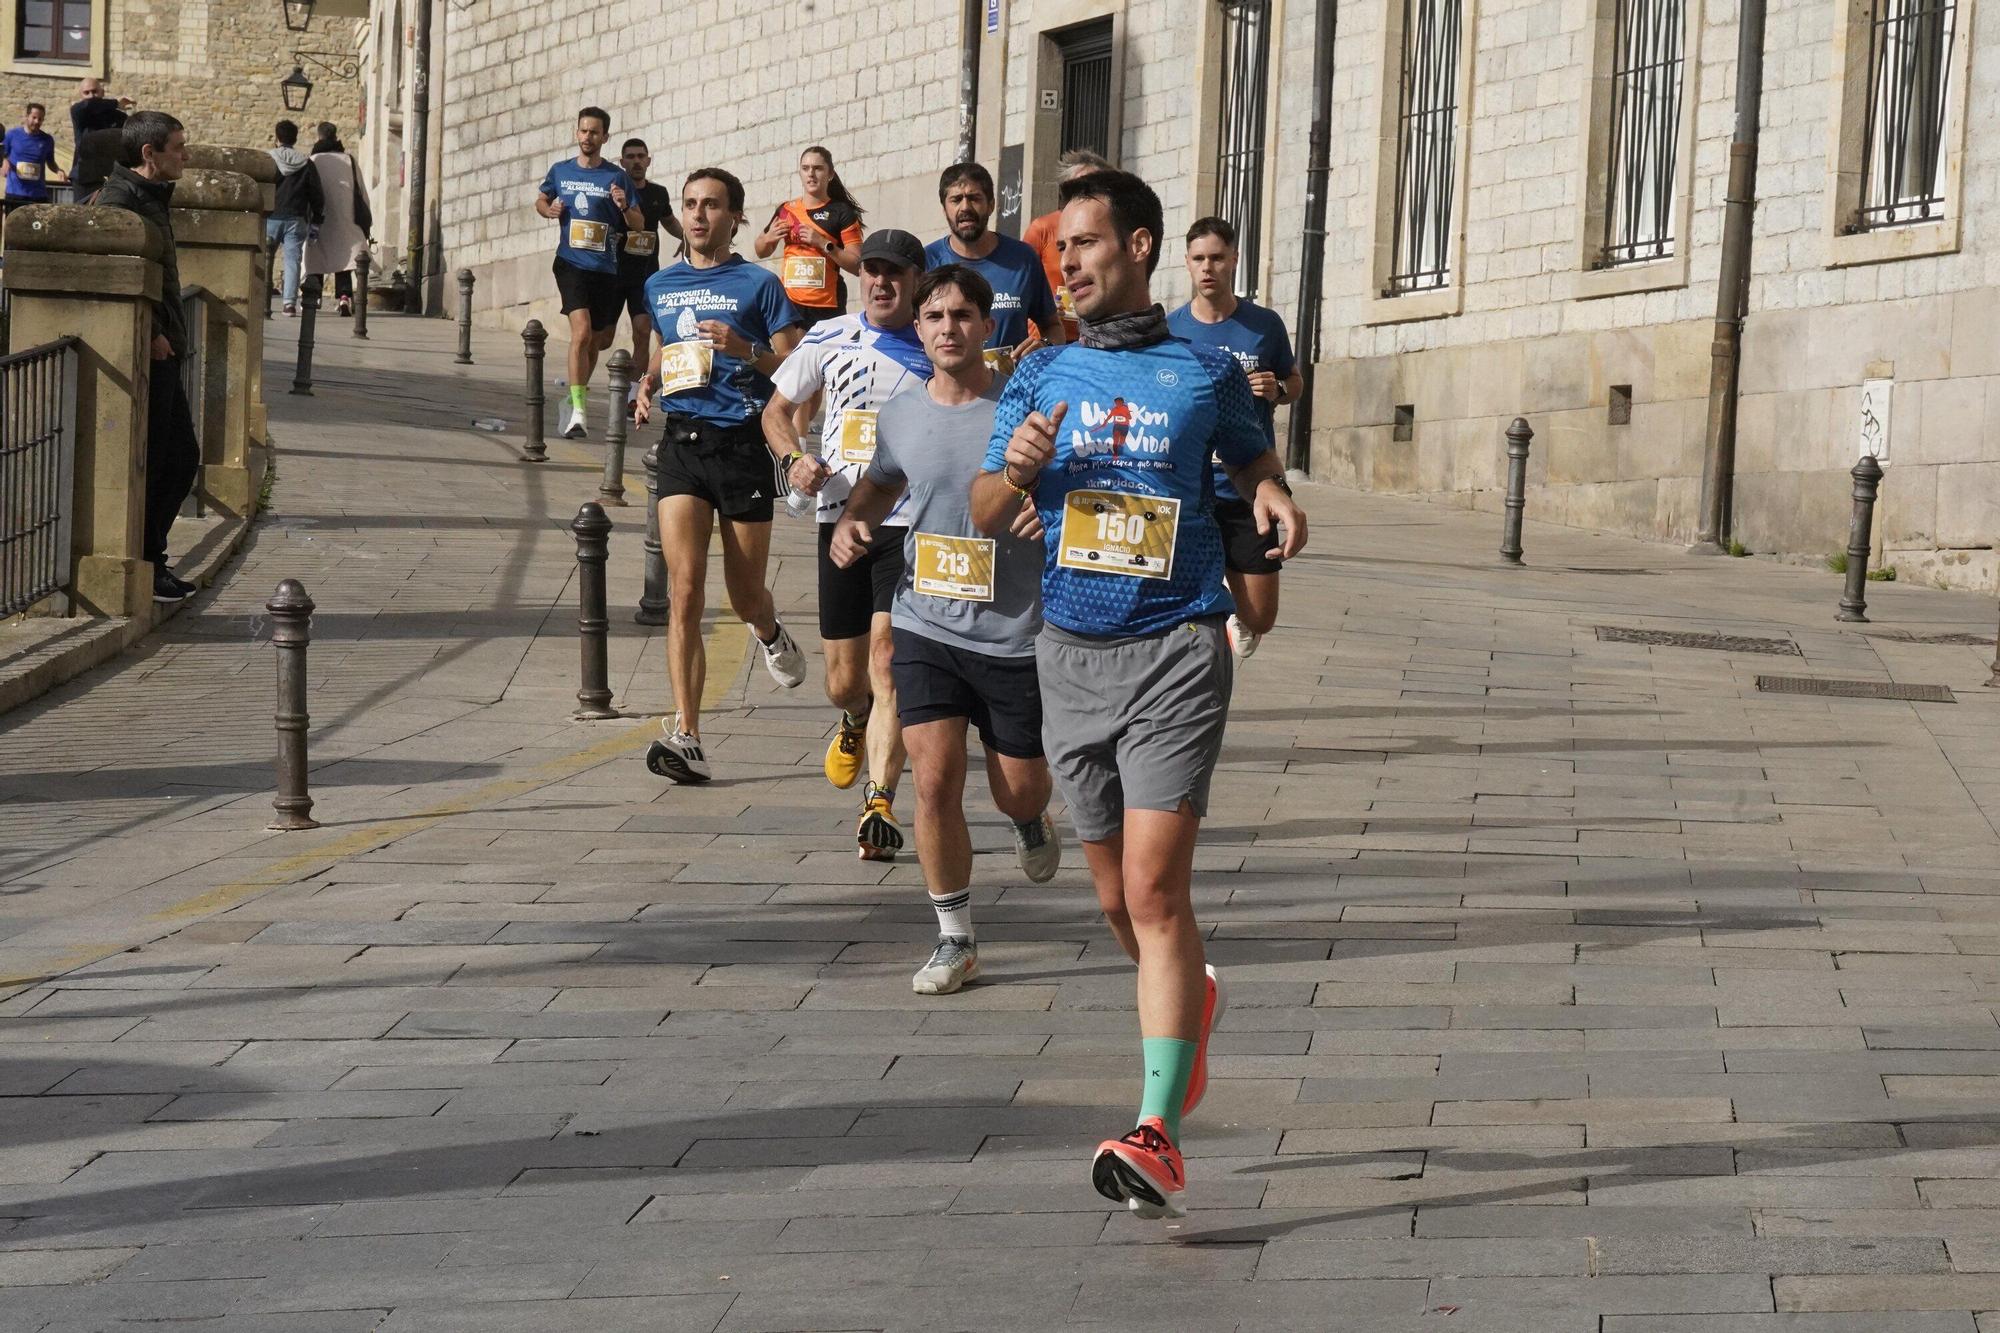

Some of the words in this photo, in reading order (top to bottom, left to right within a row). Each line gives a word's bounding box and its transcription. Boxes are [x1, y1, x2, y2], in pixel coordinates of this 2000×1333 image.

[583, 227, 594, 239] 15
[794, 264, 814, 276] 256
[658, 293, 666, 301] LA
[666, 288, 711, 300] CONQUISTA
[665, 294, 726, 307] ALMENDRA
[695, 303, 738, 311] KONKISTA
[1125, 426, 1170, 454] VIDA
[1112, 460, 1133, 469] cerca
[1137, 460, 1151, 474] que
[1096, 512, 1145, 545] 150
[1103, 544, 1131, 553] IGNACIO
[936, 550, 970, 576] 213
[1152, 1069, 1160, 1077] K
